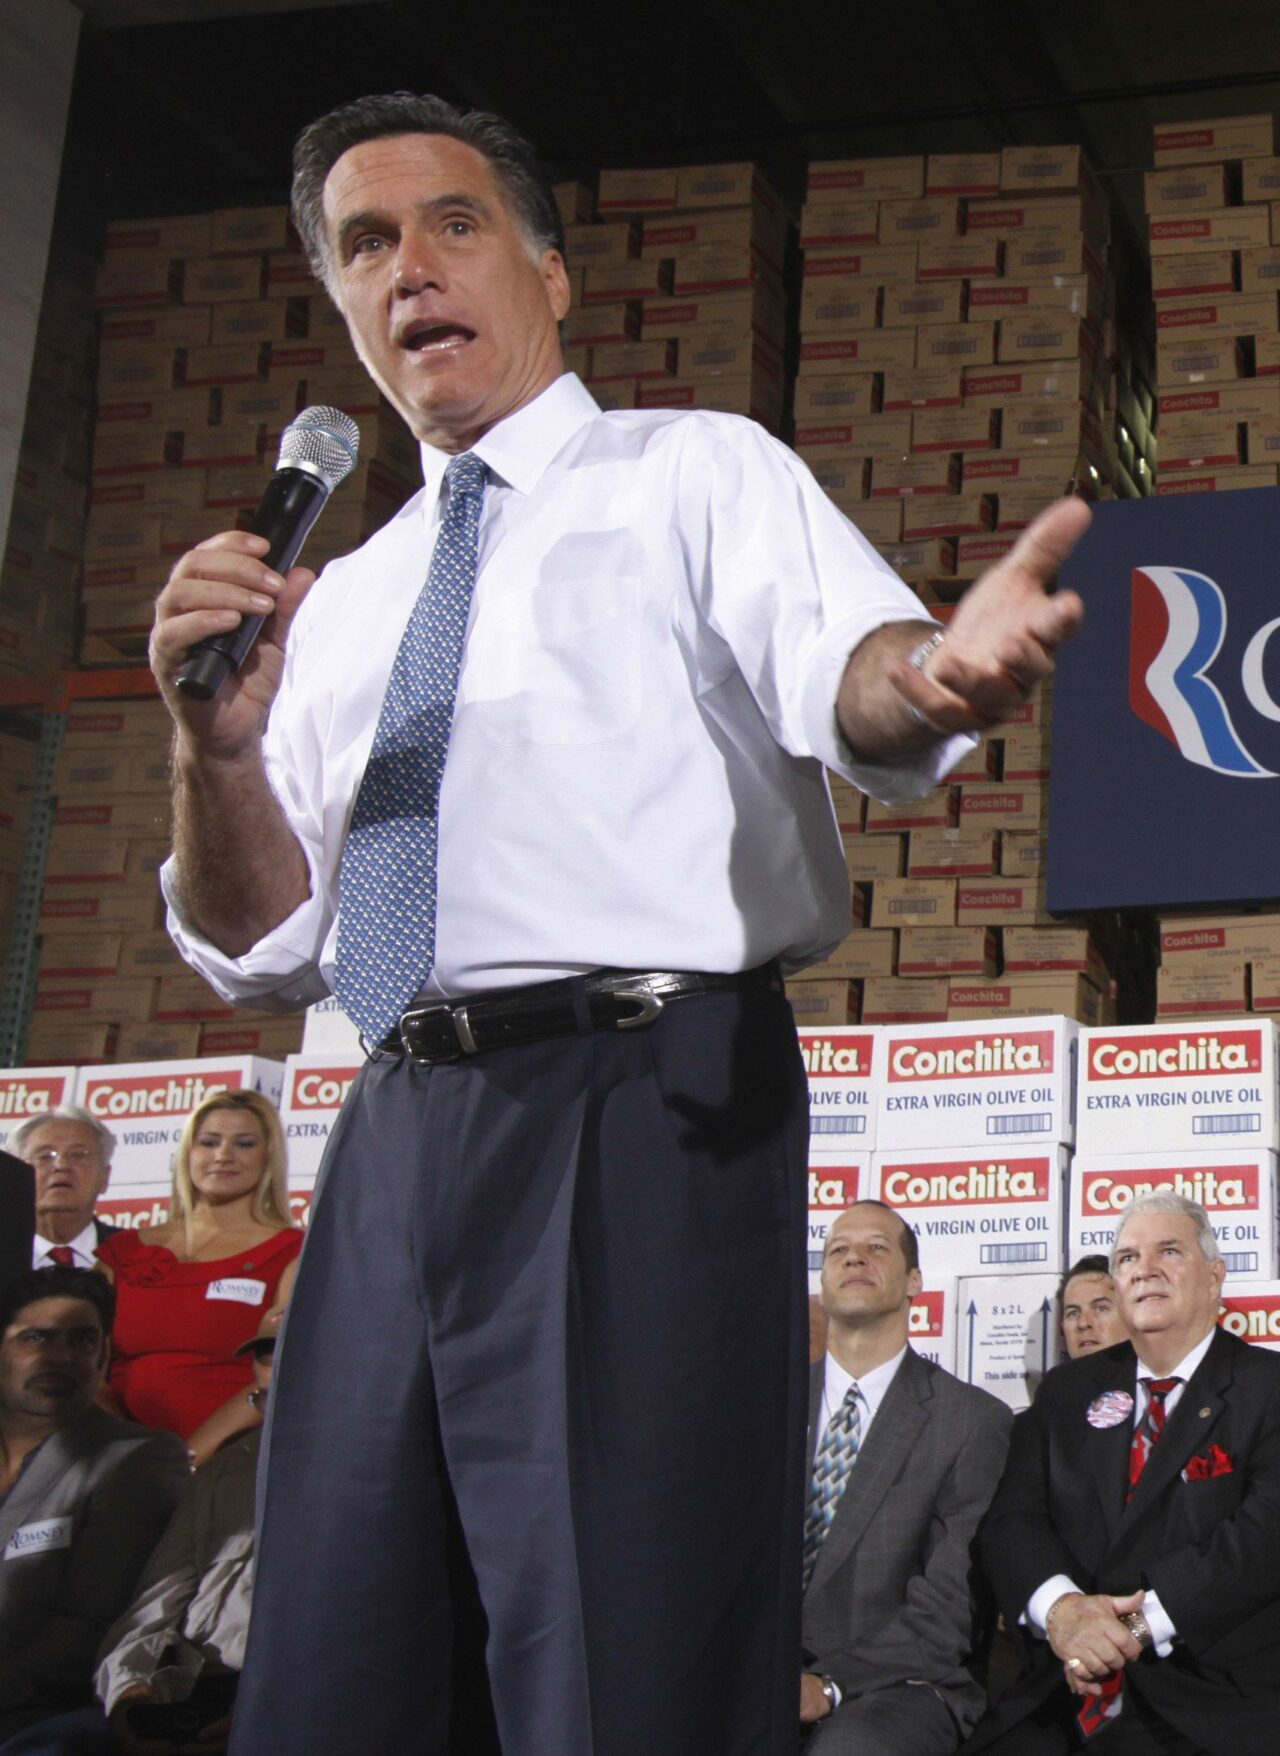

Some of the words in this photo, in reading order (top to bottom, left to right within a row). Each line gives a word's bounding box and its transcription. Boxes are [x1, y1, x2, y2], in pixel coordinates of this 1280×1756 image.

[1154, 224, 1204, 236] Conchita
[1160, 310, 1211, 323] Conchita
[967, 378, 1016, 391] Conchita
[1163, 395, 1213, 408] Conchita
[1158, 481, 1210, 494] Conchita
[963, 797, 1016, 809] Conchita
[961, 892, 1016, 905] Conchita
[1165, 933, 1219, 946] Conchita
[951, 990, 1003, 1002] Conchita
[893, 1037, 1042, 1077] Conchita
[1092, 1037, 1249, 1075] Conchita
[846, 1090, 869, 1105] OIL
[886, 1095, 929, 1112] EXTRA
[933, 1091, 982, 1109] VIRGIN
[986, 1089, 1026, 1106] OLIVE
[1030, 1087, 1054, 1102] OIL
[1087, 1094, 1131, 1110] EXTRA
[1136, 1091, 1187, 1107] VIRGIN
[1192, 1089, 1233, 1104] OLIVE
[1238, 1088, 1263, 1103] OIL
[123, 1130, 168, 1145] VIRGIN
[286, 1123, 329, 1138] EXTRA
[884, 1164, 1037, 1204] Conchita
[926, 1219, 976, 1236] VIRGIN
[979, 1217, 1020, 1233] OLIVE
[1025, 1215, 1049, 1231] OIL
[1235, 1225, 1260, 1240] OIL
[1008, 1305, 1015, 1315] 2
